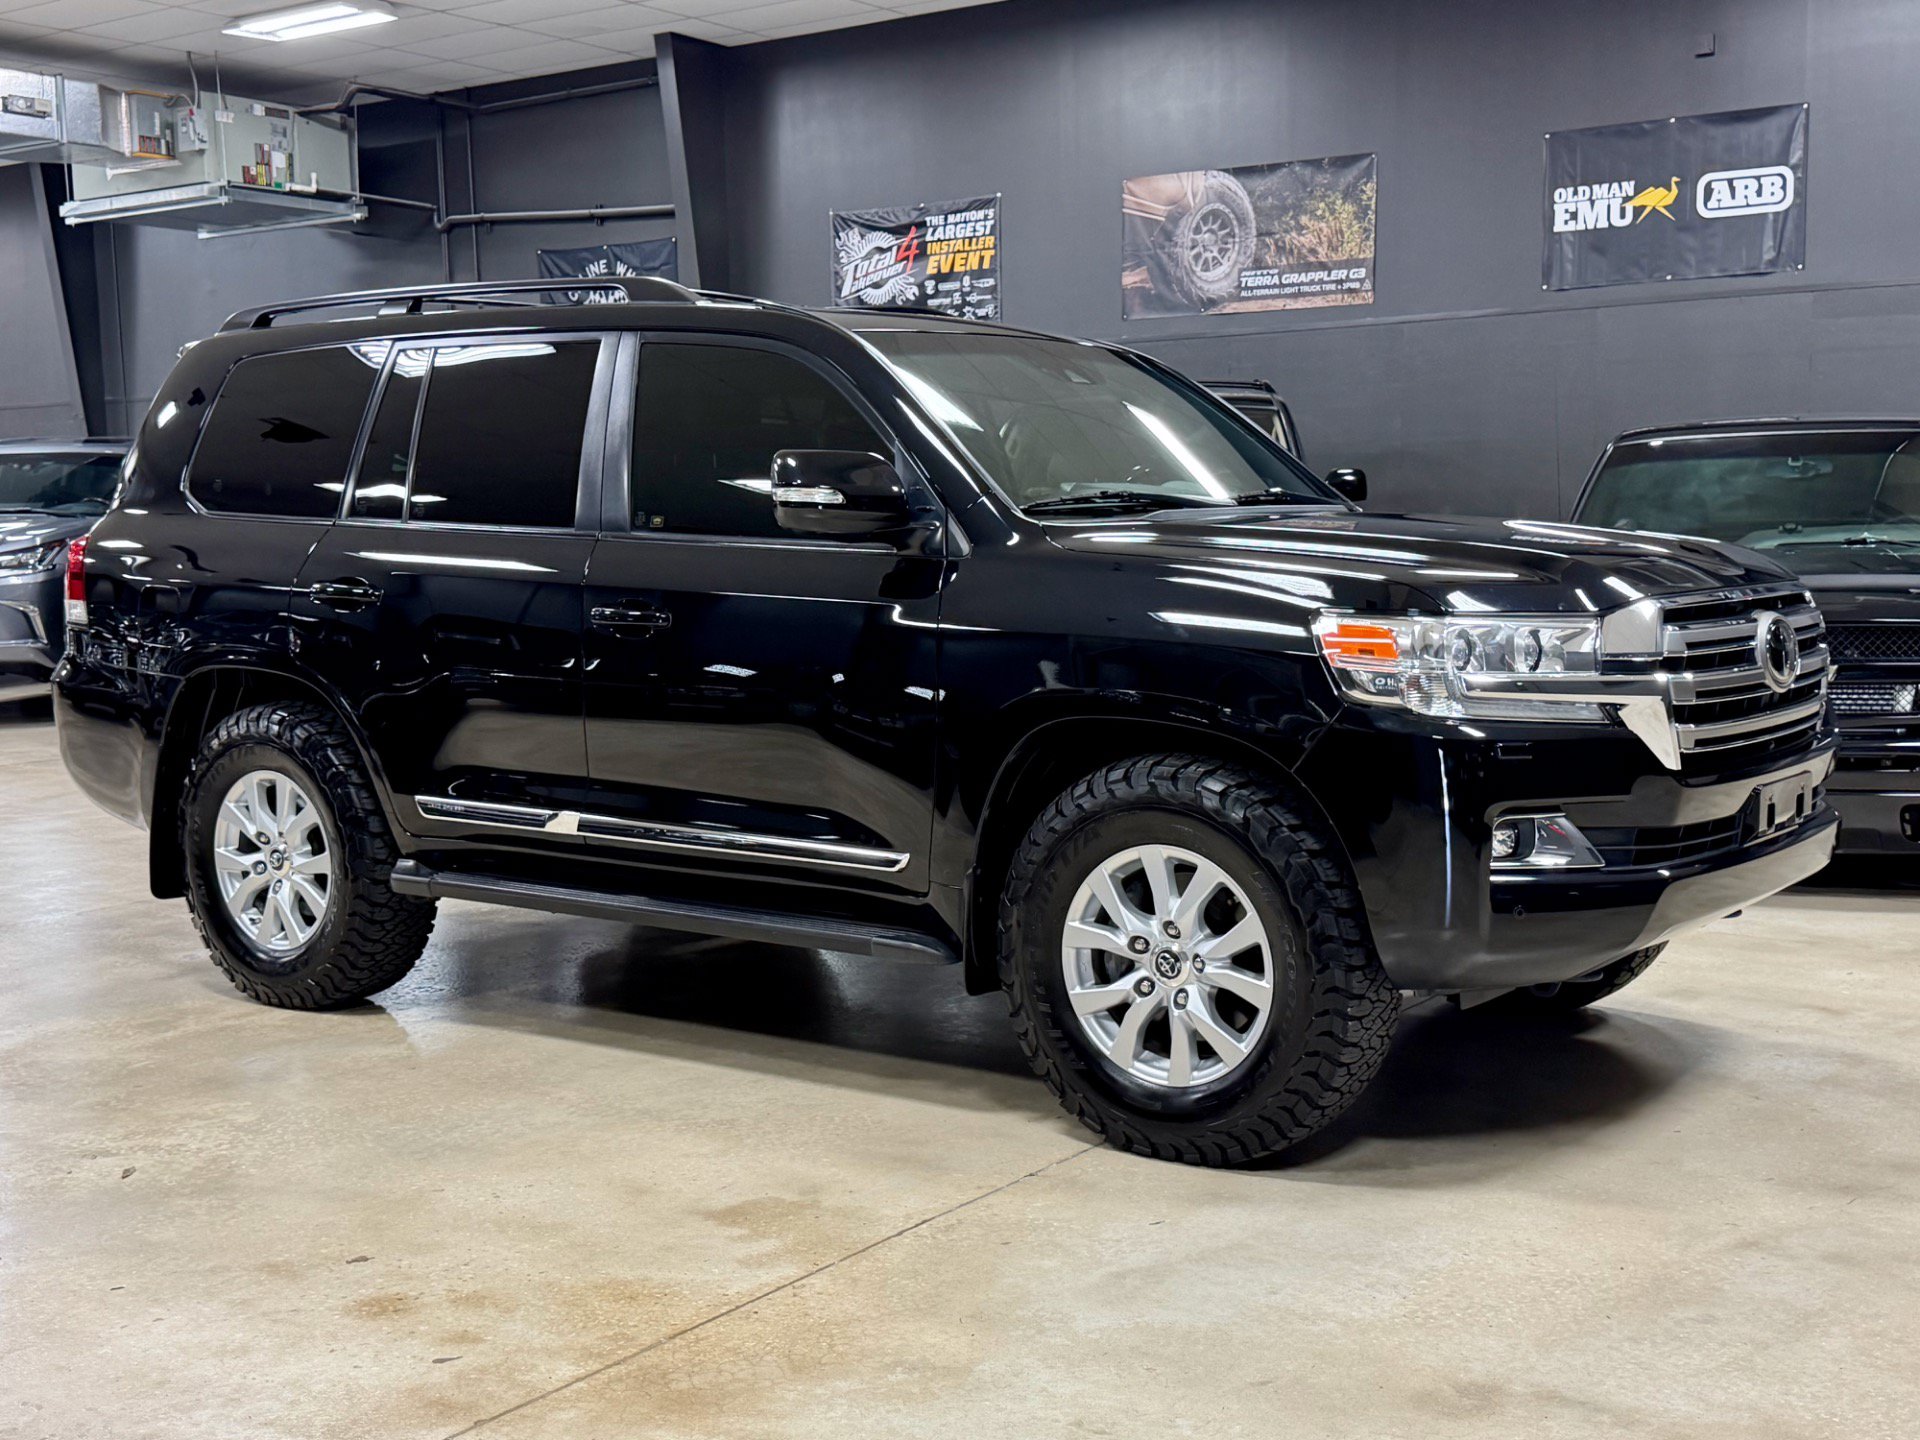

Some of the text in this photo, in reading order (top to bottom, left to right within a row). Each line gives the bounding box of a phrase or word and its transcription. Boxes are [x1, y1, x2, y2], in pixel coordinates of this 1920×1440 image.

[1553, 181, 1635, 203] OLD MAN
[1706, 175, 1784, 209] ARB
[925, 208, 995, 227] THE NATION'S
[1553, 197, 1634, 233] EMU
[925, 220, 995, 241] LARGEST
[896, 226, 920, 273] 4
[926, 236, 996, 255] INSTALLER
[926, 249, 996, 275] EVENT
[1240, 267, 1367, 287] TERRA GRAPPLER G3
[1240, 288, 1280, 297] ALL-TERRAIN
[1281, 286, 1299, 294] LIGHT
[1300, 284, 1321, 293] TRUCK
[1322, 283, 1337, 291] TIRE
